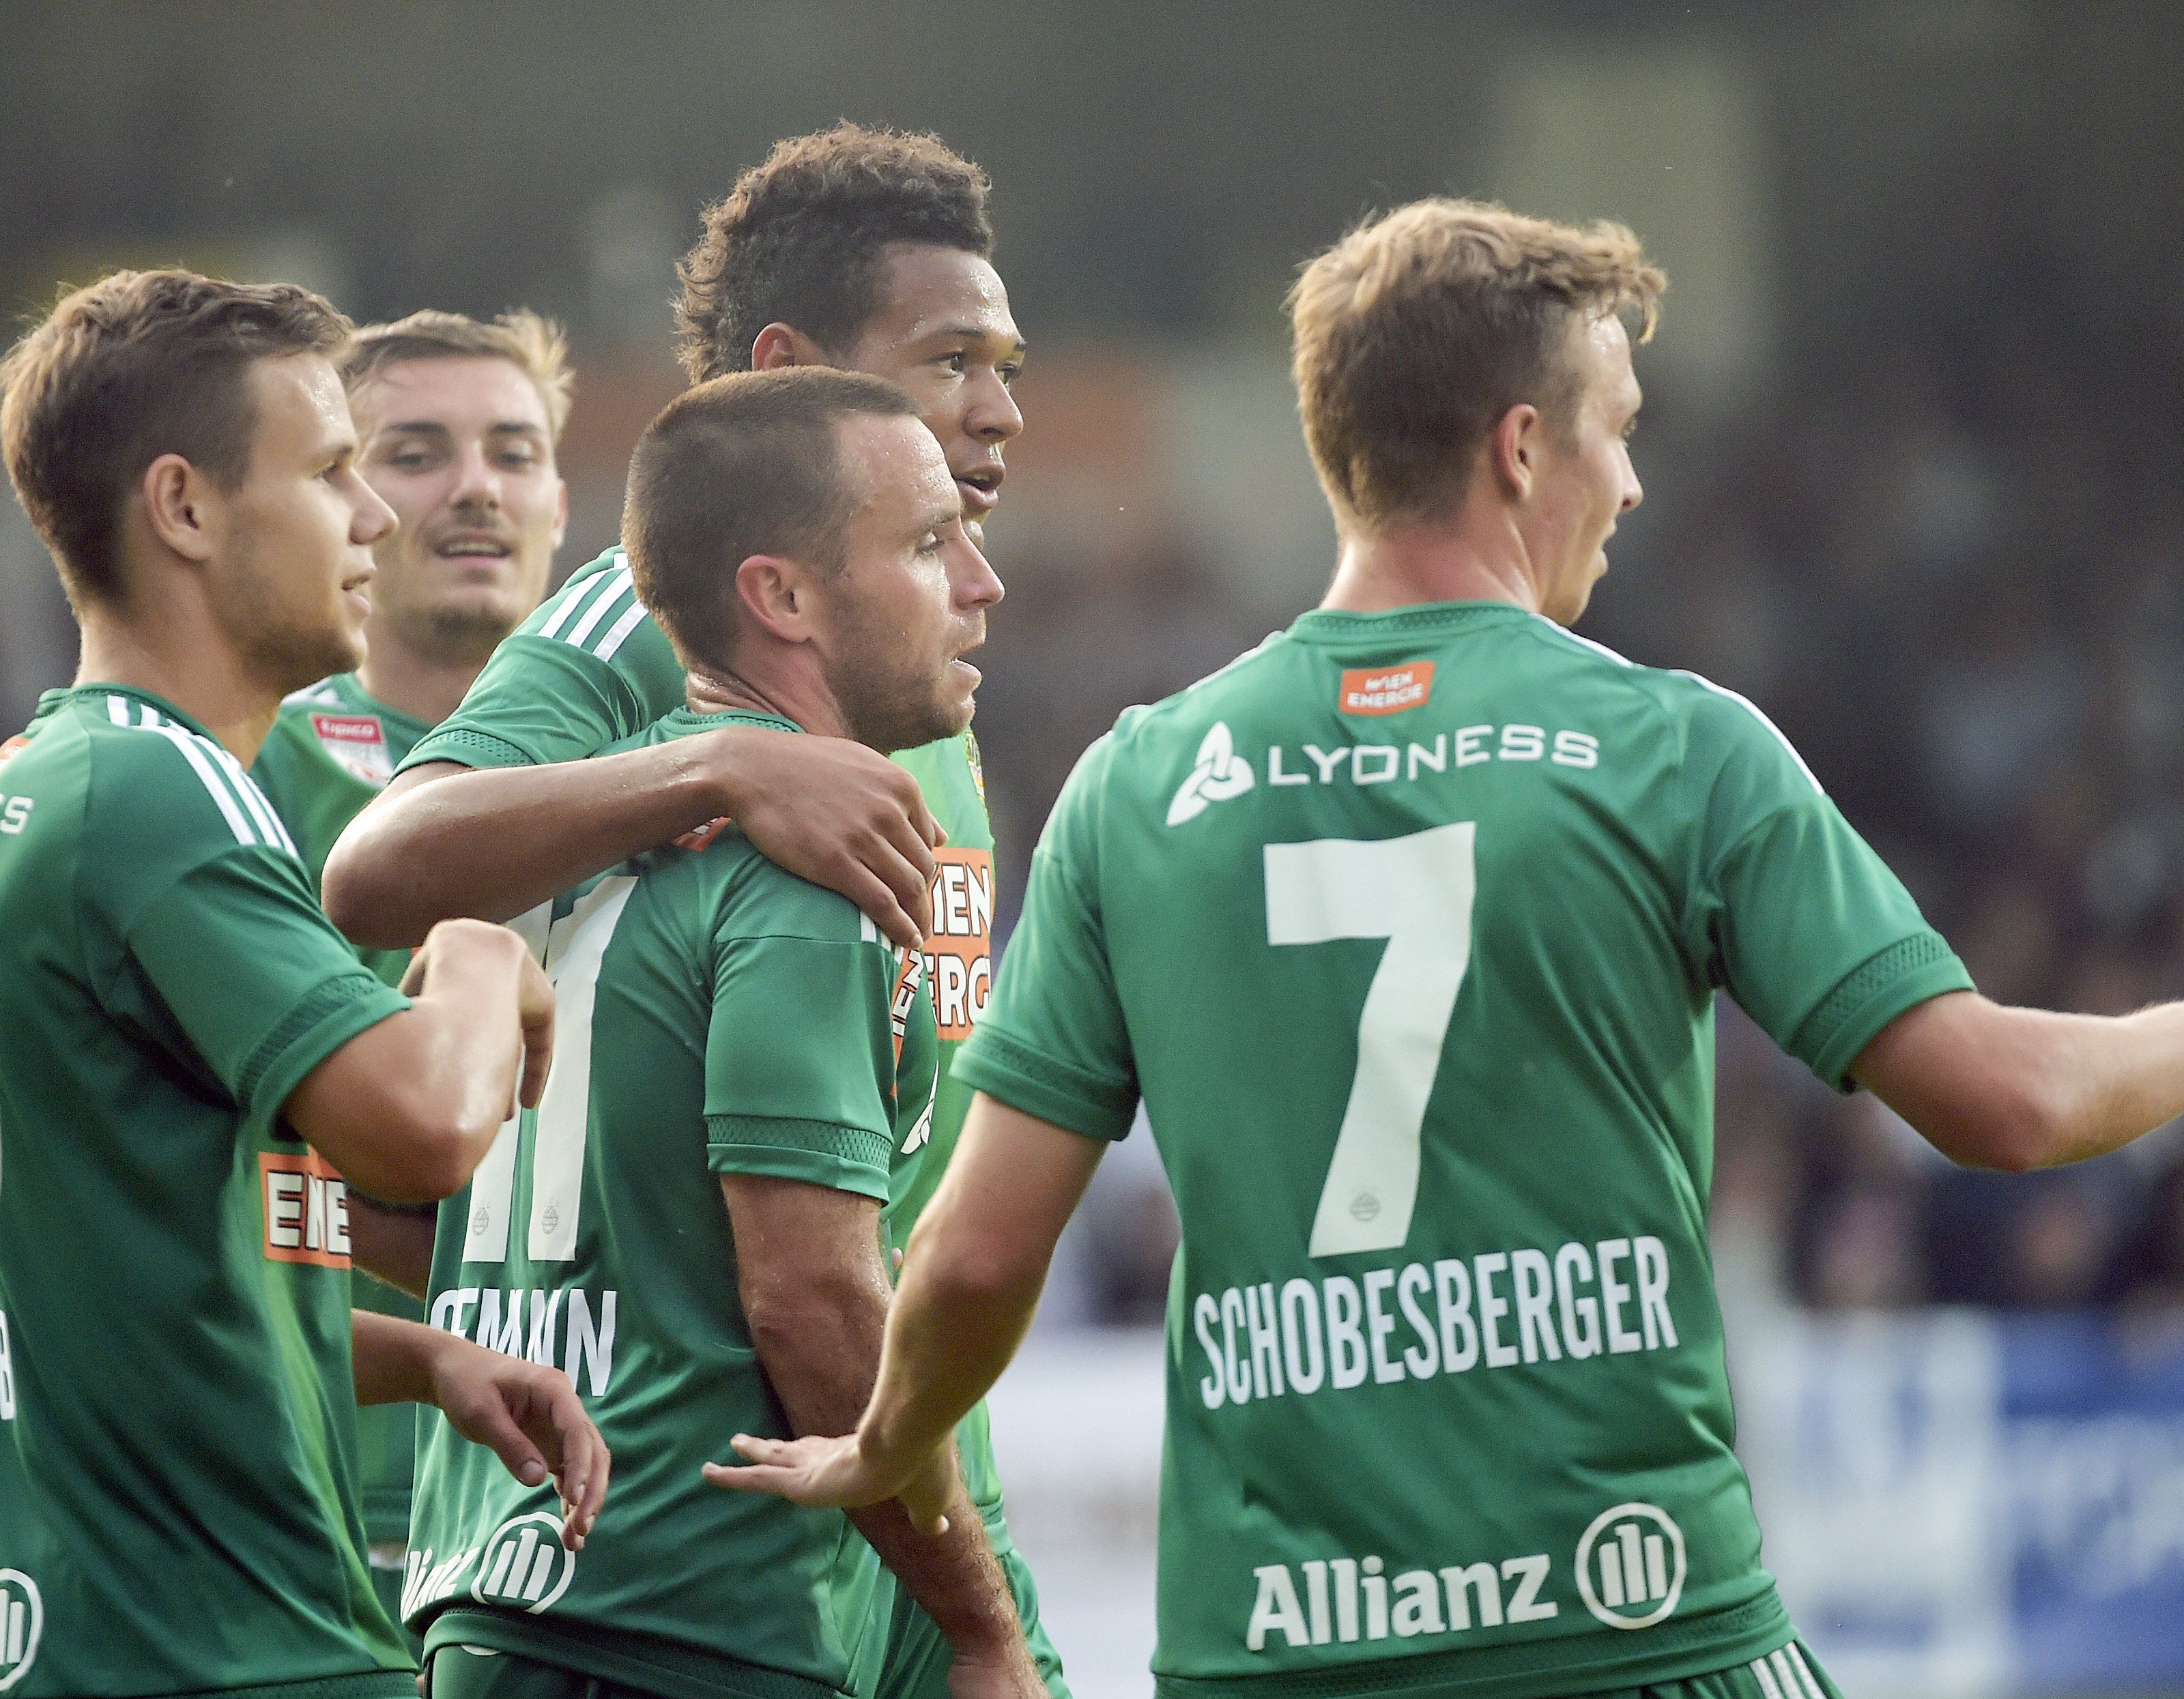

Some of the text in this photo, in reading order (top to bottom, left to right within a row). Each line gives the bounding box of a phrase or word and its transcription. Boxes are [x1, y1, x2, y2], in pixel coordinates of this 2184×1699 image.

[1267, 723, 1600, 786] LYONESS
[1263, 821, 1476, 1258] 7
[1194, 1236, 1679, 1410] SCHOBESBERGER
[1246, 1554, 1559, 1651] Allianz
